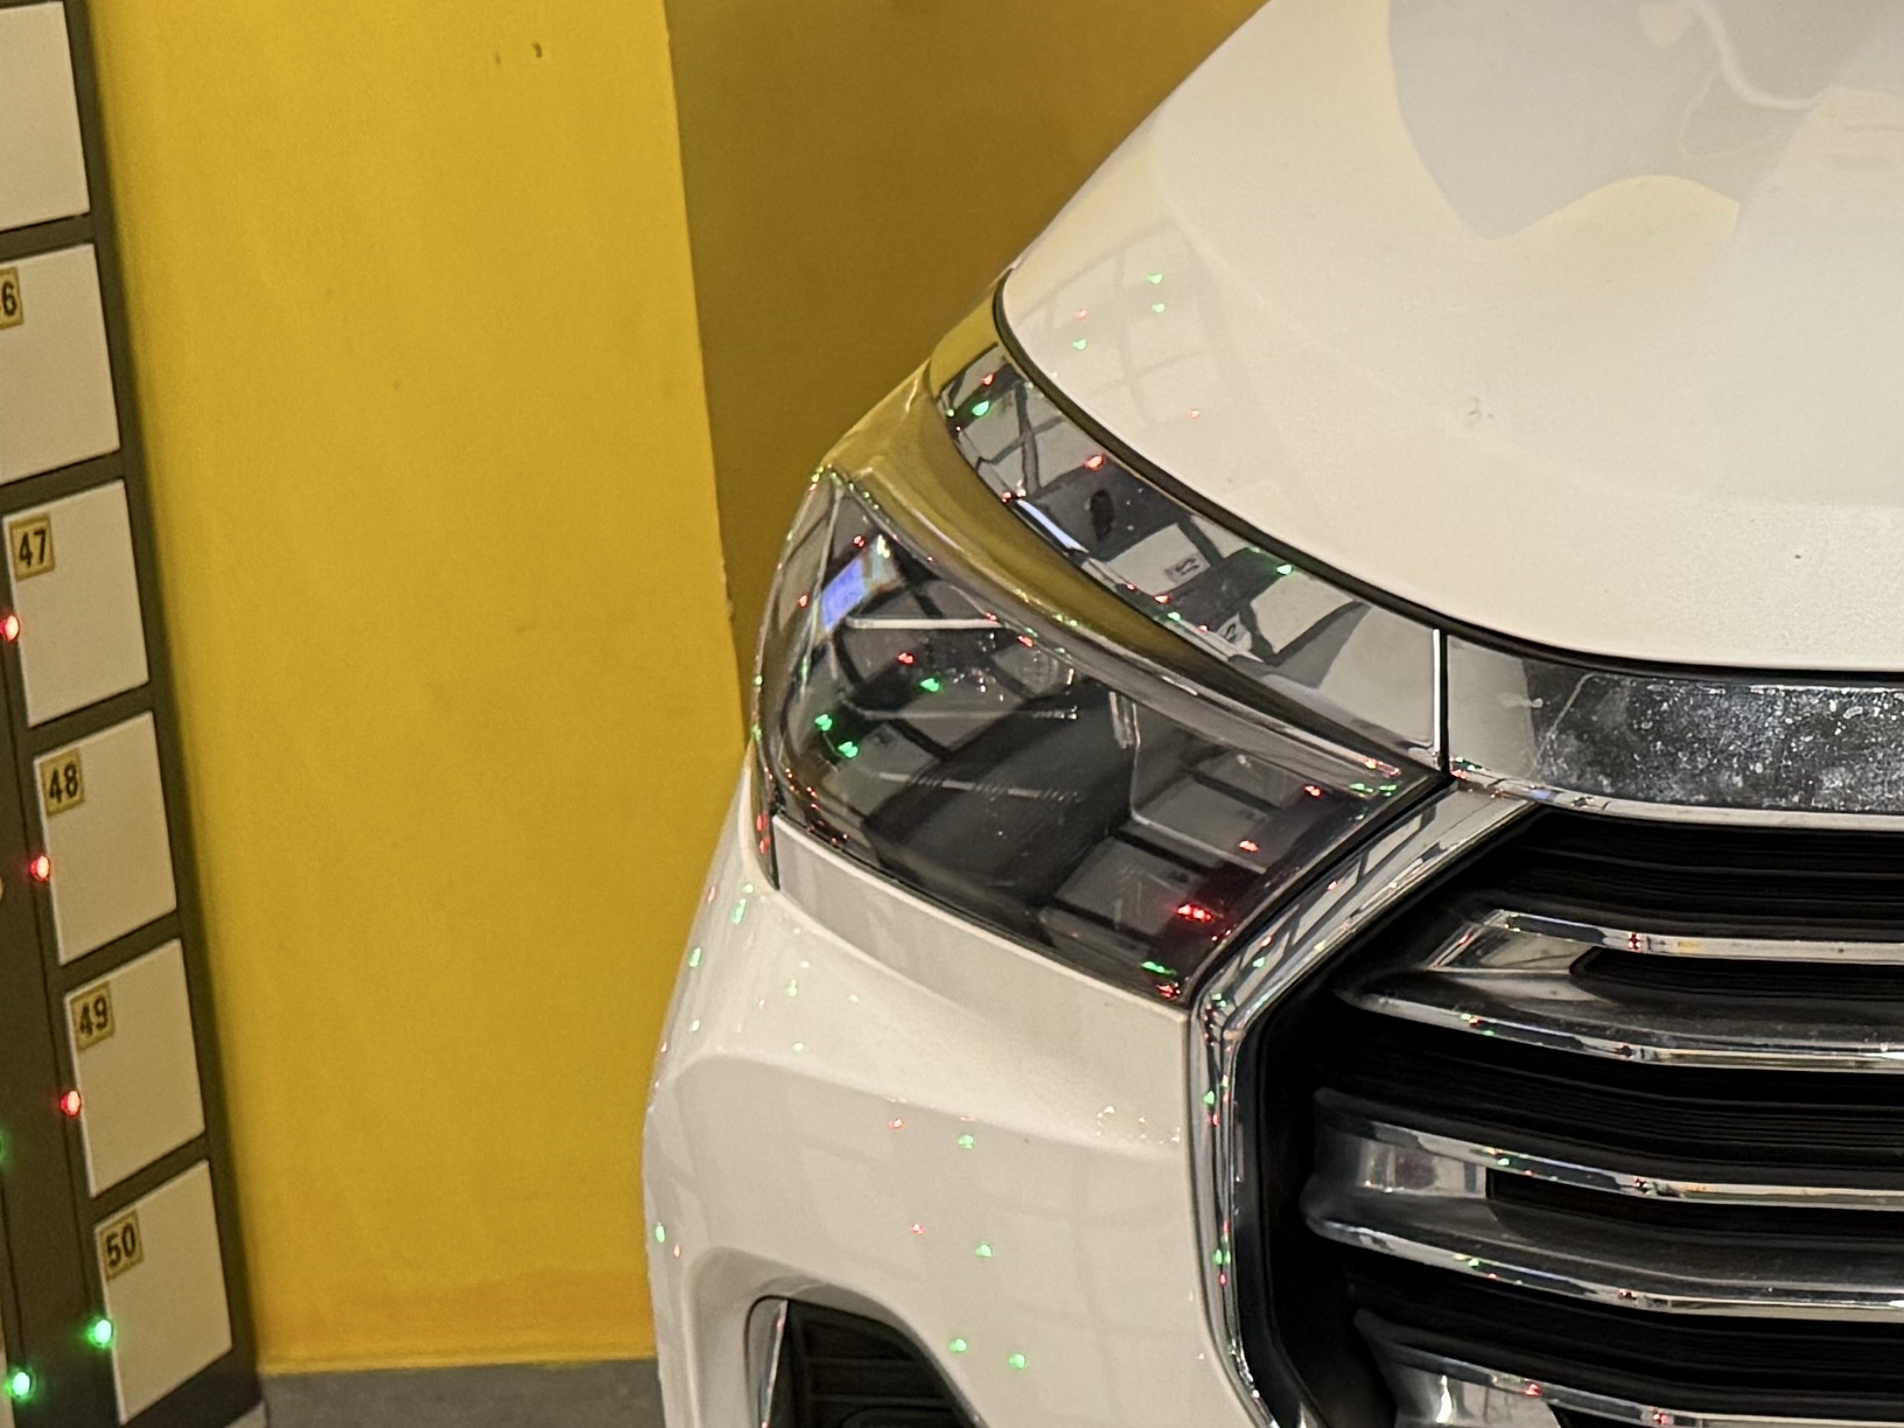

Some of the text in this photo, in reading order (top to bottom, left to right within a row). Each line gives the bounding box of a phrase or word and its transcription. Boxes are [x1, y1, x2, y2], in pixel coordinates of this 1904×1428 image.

[0, 281, 17, 317] 6
[18, 528, 47, 567] 47
[47, 763, 79, 803] 48
[77, 998, 109, 1037] 49
[105, 1222, 136, 1267] 50
